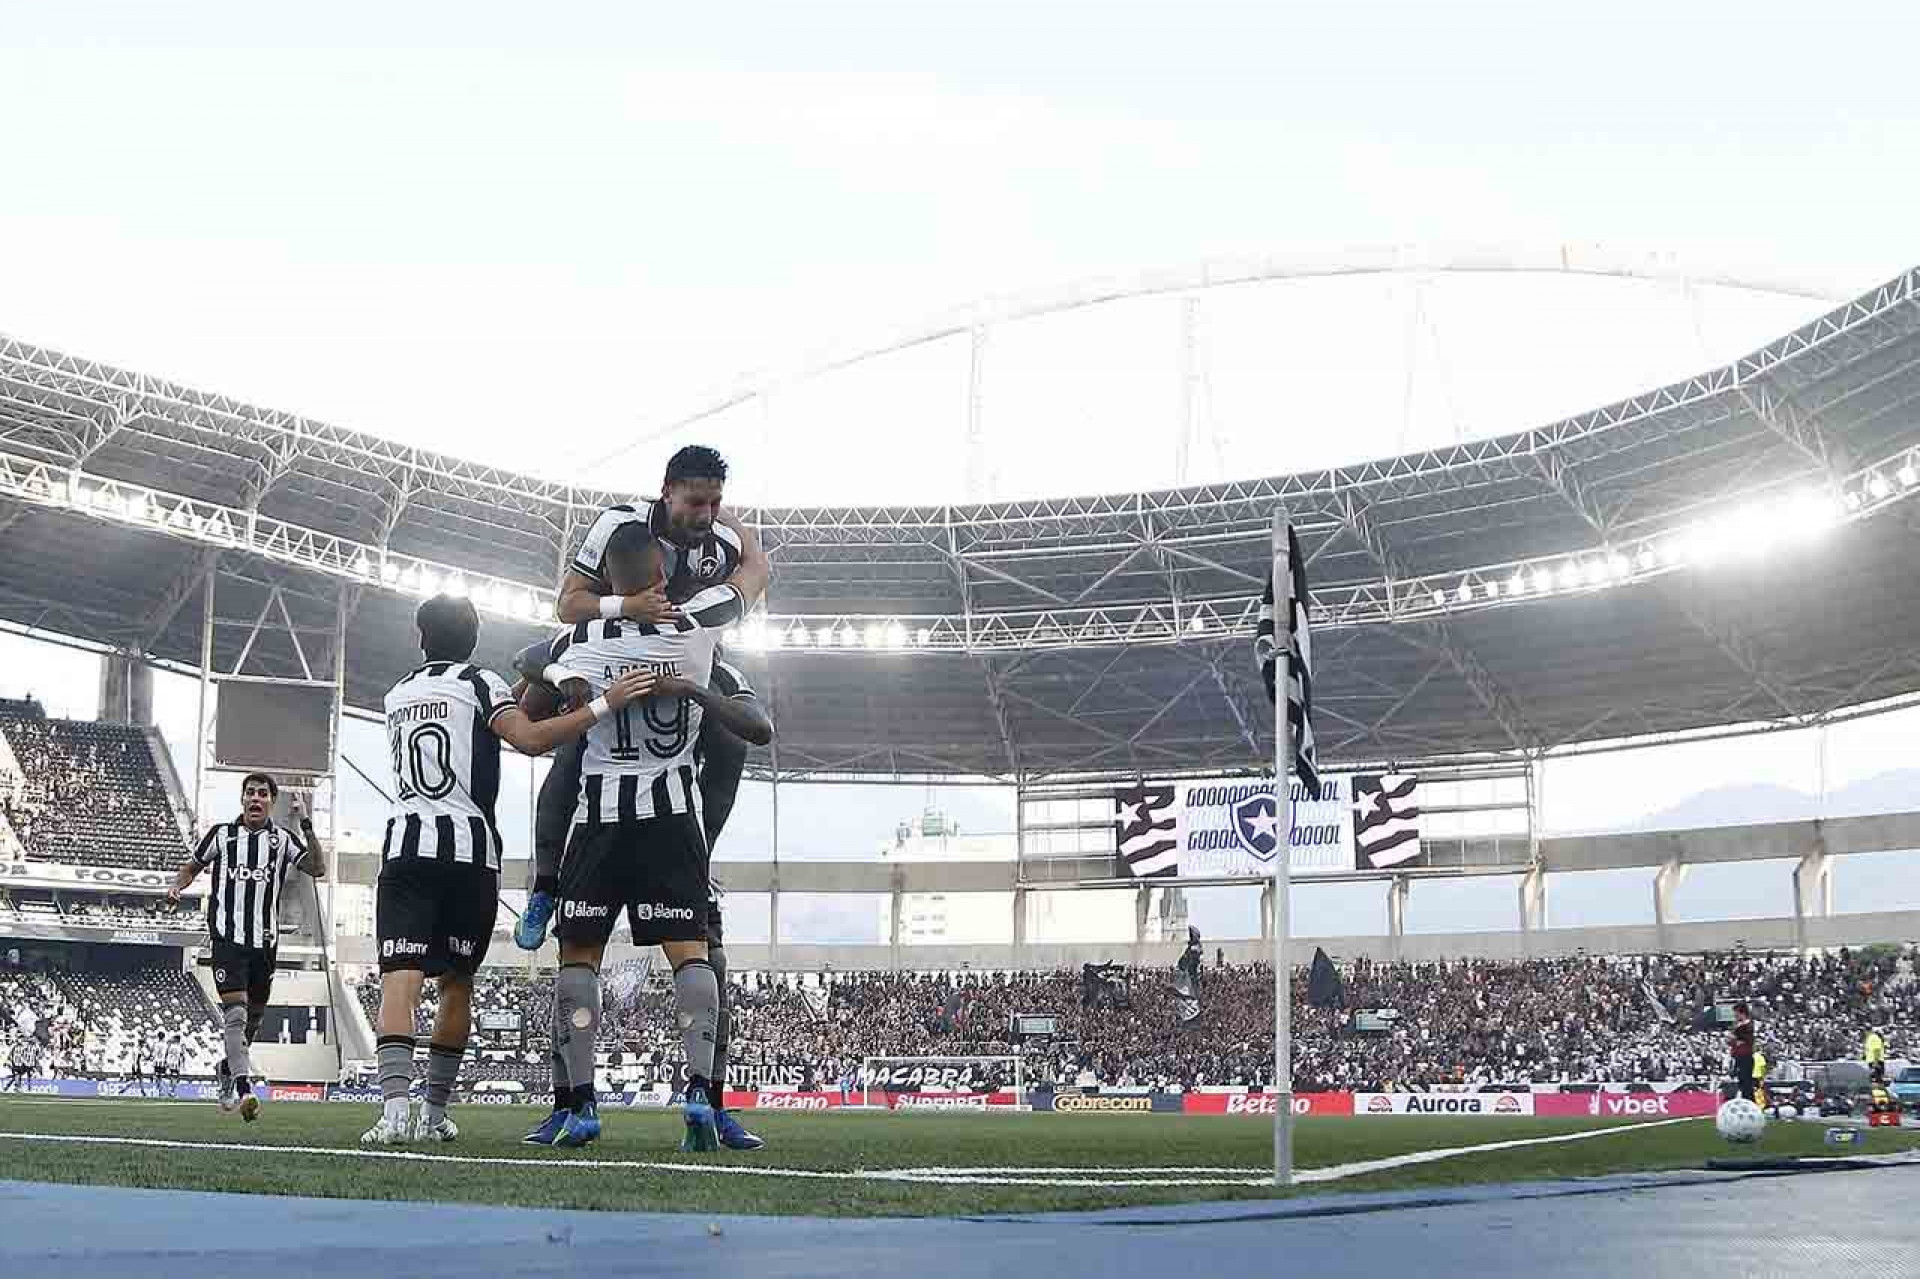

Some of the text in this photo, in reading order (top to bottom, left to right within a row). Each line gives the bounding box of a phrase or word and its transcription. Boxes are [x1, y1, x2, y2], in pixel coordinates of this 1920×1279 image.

[388, 701, 448, 728] MONTORO
[610, 695, 690, 760] 19
[392, 723, 457, 801] 10
[228, 864, 271, 883] vbet
[575, 900, 607, 917] álamo
[653, 902, 694, 920] álamo
[395, 938, 428, 955] álam
[755, 1092, 829, 1109] Betano
[1405, 1095, 1481, 1113] Aurora
[1608, 1095, 1669, 1115] vbet
